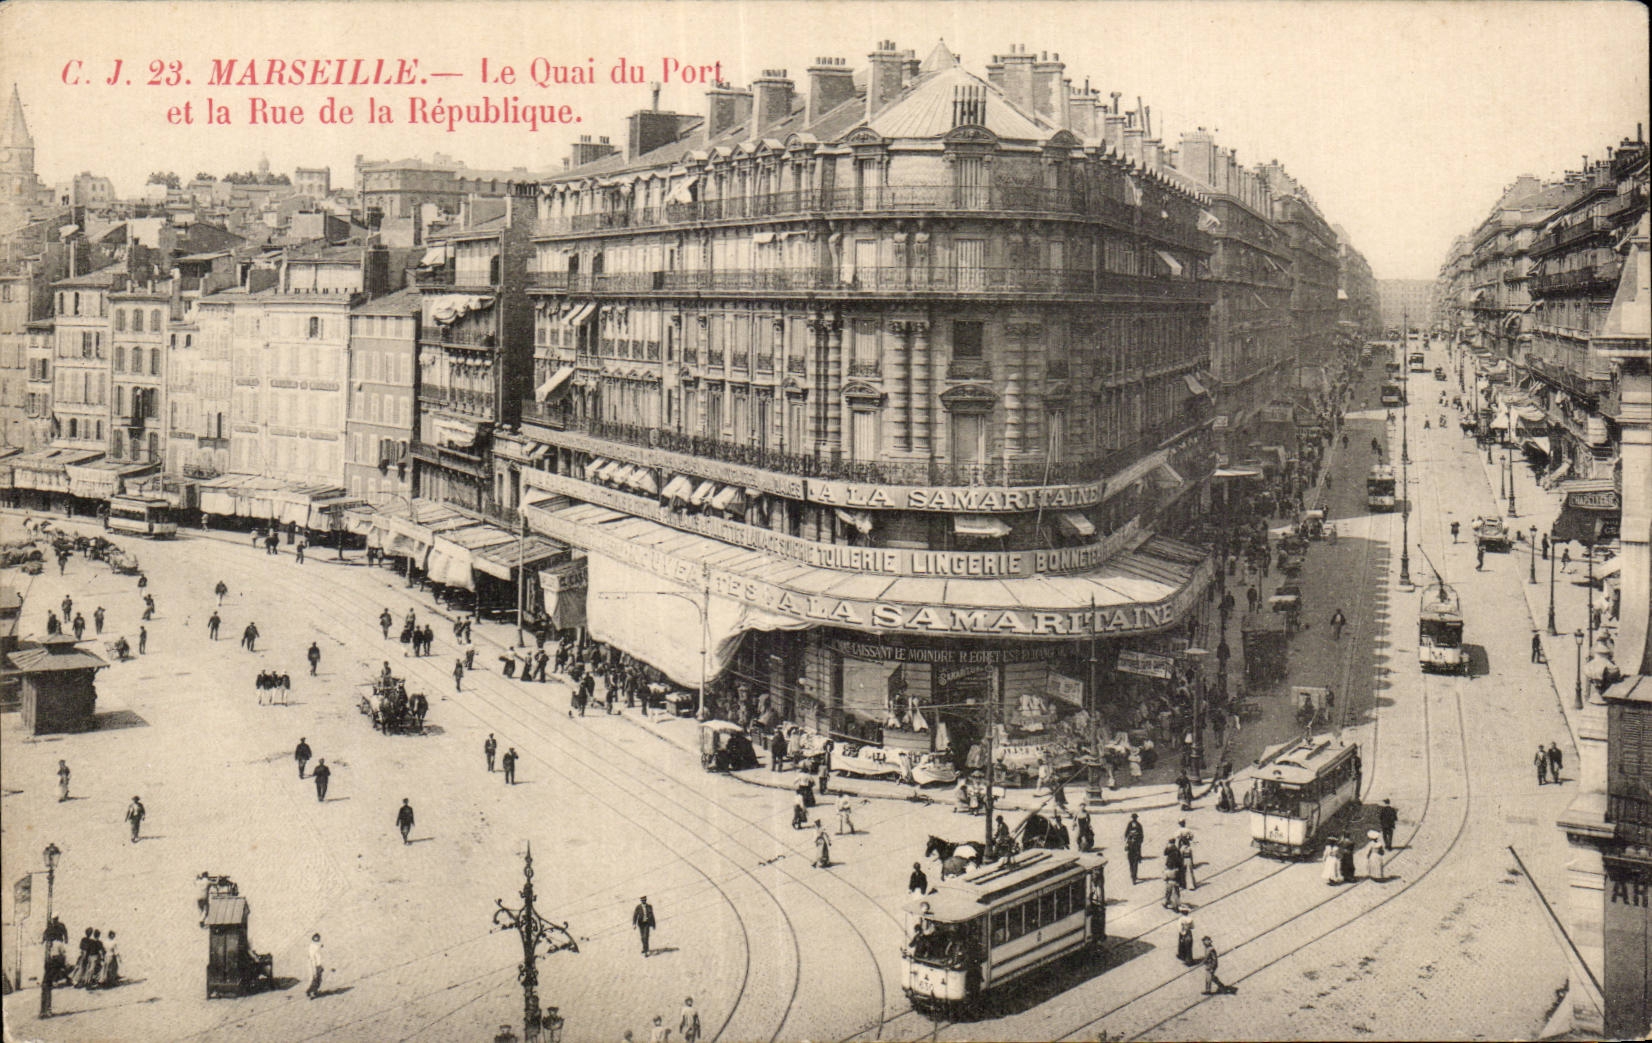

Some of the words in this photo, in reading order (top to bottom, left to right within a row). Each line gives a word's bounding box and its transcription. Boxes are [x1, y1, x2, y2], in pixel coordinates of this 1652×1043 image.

[817, 484, 836, 504] A
[846, 485, 896, 509] LA
[907, 484, 1099, 512] SAMARITAINE
[815, 547, 897, 574] TOILERIE
[911, 552, 1022, 576] LINGERIE
[805, 597, 863, 625] LA
[871, 602, 1175, 636] SAMARITAINE
[908, 648, 955, 663] MOINDRE
[959, 650, 1001, 664] REGRET
